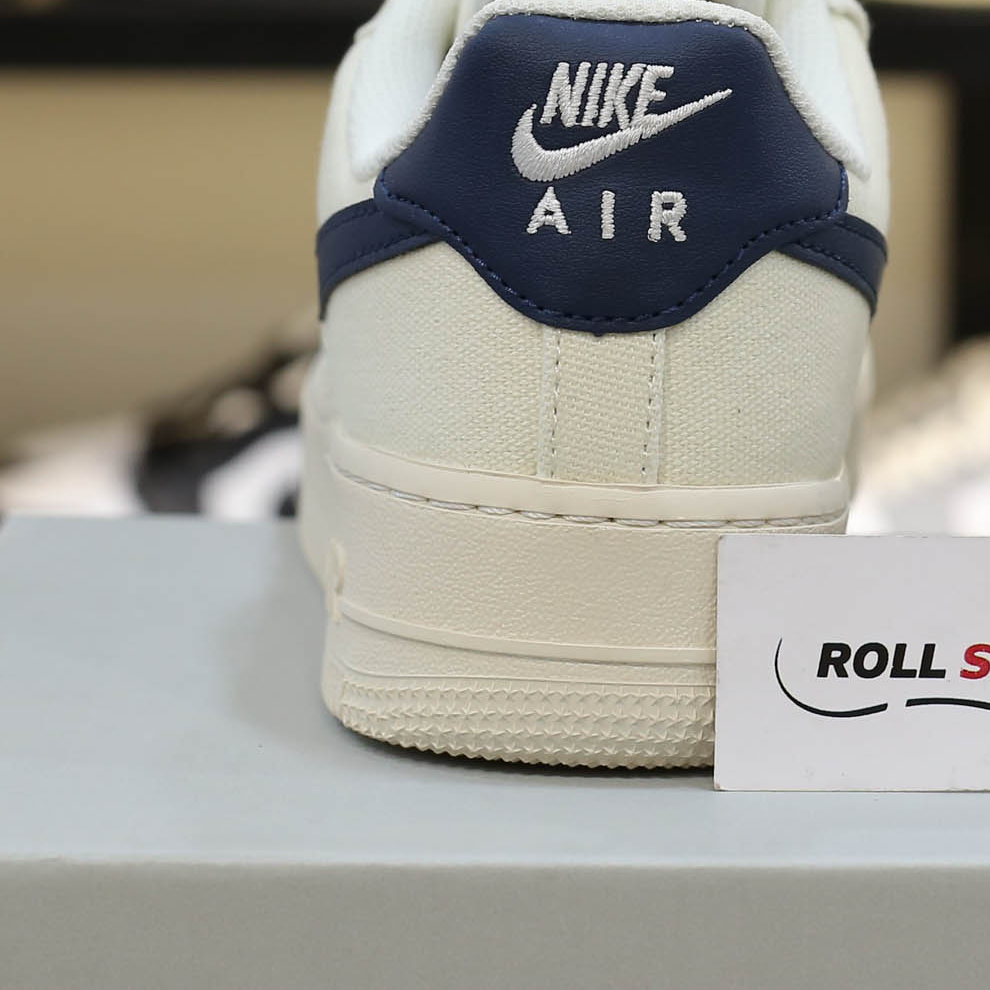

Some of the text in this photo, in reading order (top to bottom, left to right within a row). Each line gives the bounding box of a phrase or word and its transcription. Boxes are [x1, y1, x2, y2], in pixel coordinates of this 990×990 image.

[539, 61, 675, 130] NIKE
[525, 186, 688, 243] AIR
[816, 641, 947, 680] ROLL
